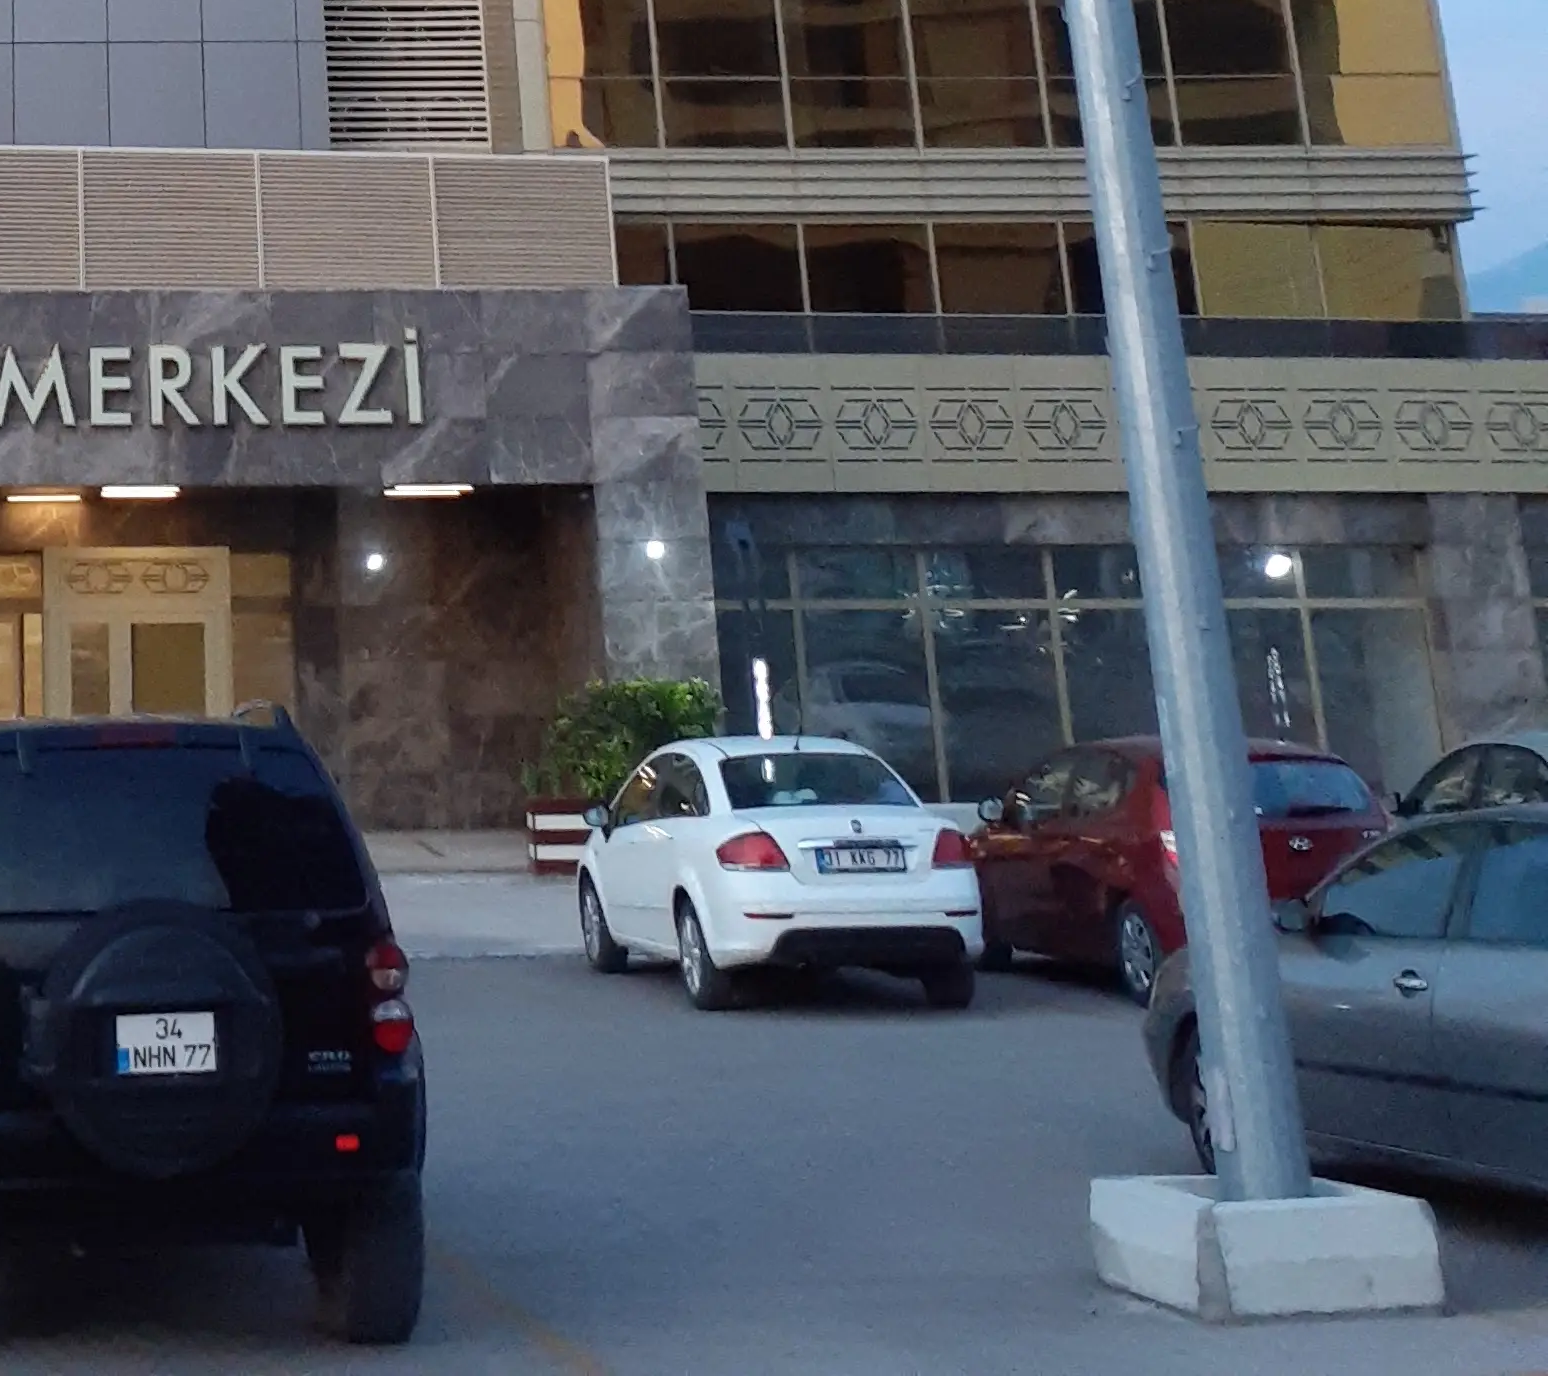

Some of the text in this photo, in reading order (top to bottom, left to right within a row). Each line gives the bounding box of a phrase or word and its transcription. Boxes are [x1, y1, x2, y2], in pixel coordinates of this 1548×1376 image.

[155, 1018, 183, 1040] 34
[133, 1044, 211, 1068] NHN 77
